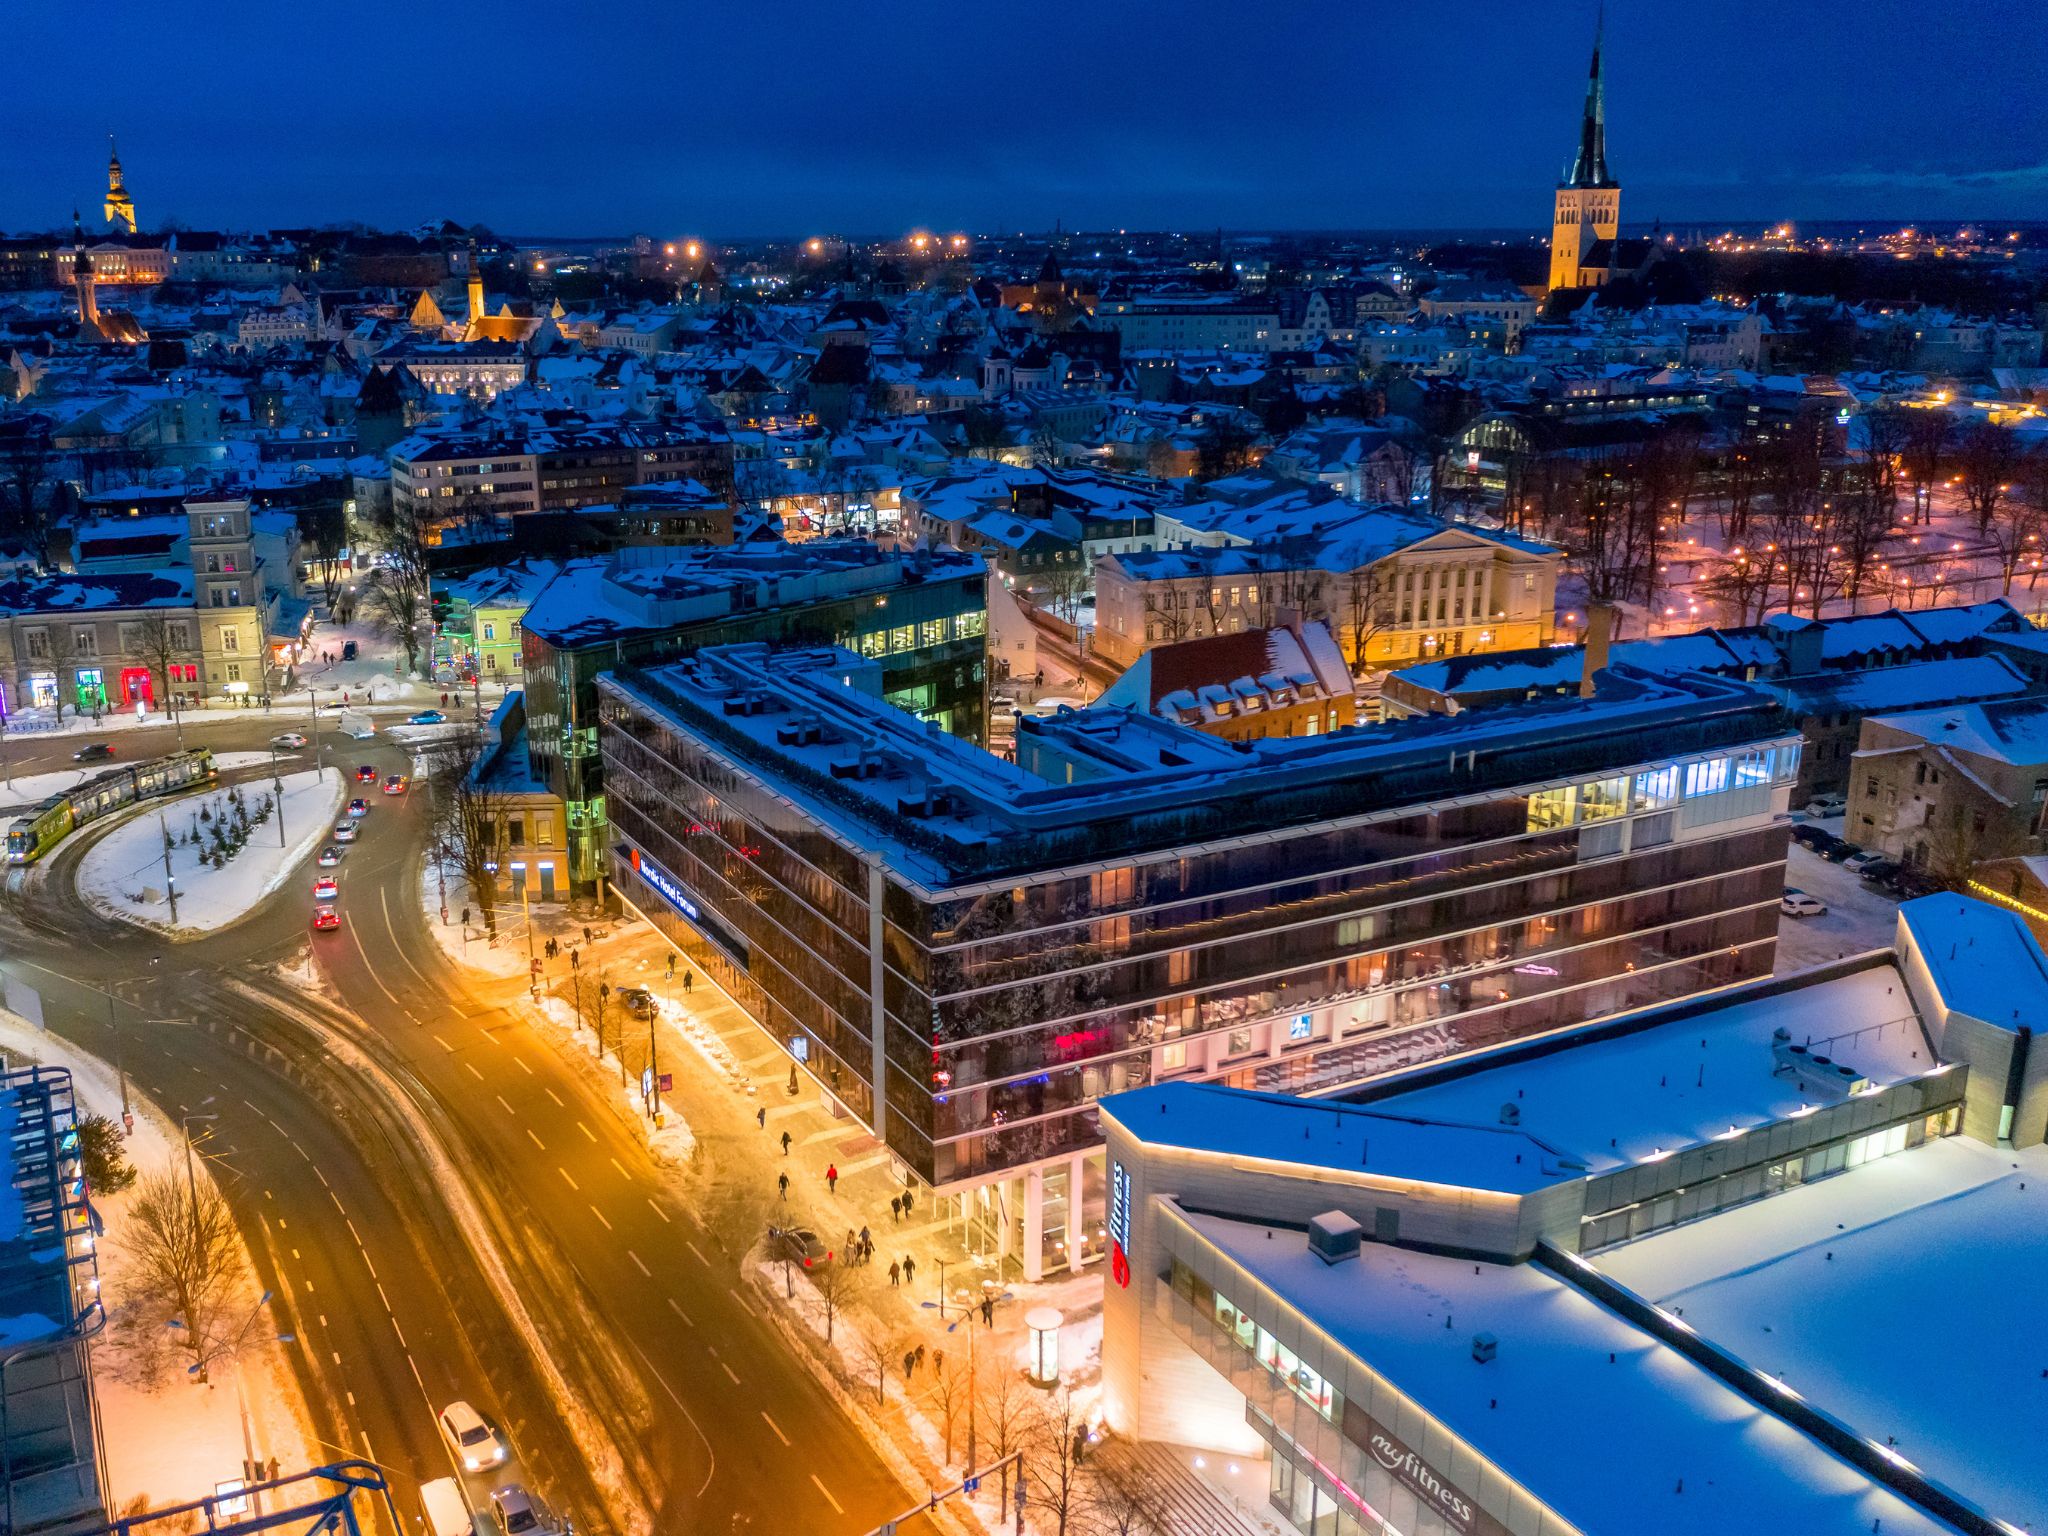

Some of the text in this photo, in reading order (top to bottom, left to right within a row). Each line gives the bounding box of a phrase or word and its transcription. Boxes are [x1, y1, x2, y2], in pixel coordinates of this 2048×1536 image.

[641, 859, 697, 919] Nordic Hotel Forum
[1370, 1434, 1472, 1521] myfitness
